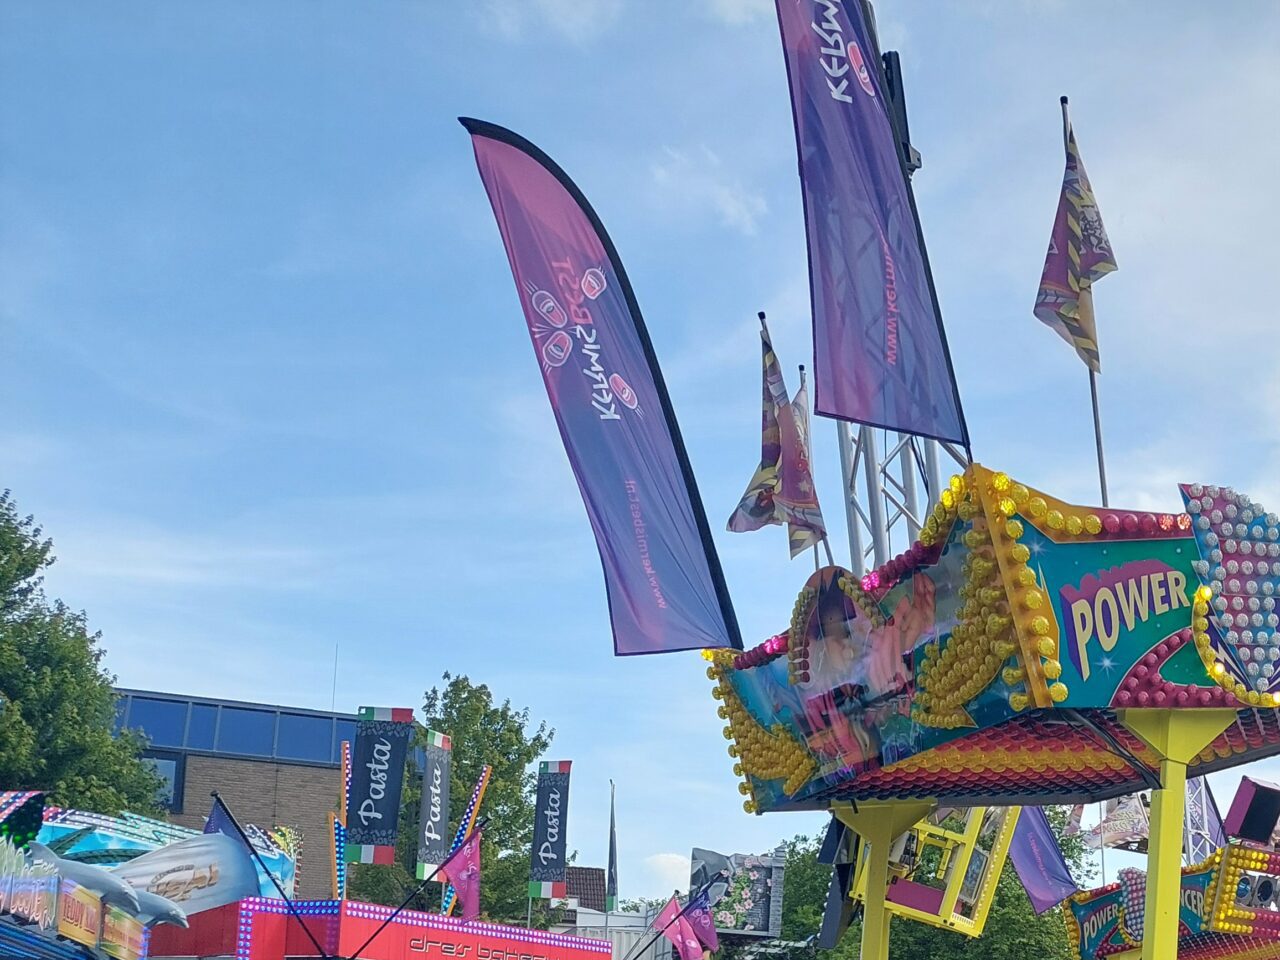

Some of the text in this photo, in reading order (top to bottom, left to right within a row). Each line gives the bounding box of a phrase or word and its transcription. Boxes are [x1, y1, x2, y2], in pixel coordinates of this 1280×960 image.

[1071, 571, 1191, 683] POWER
[357, 737, 392, 826] Pasta
[424, 763, 442, 846] Pasta
[539, 787, 562, 866] Pasta
[410, 934, 472, 958] dre's
[1083, 903, 1119, 949] POWER
